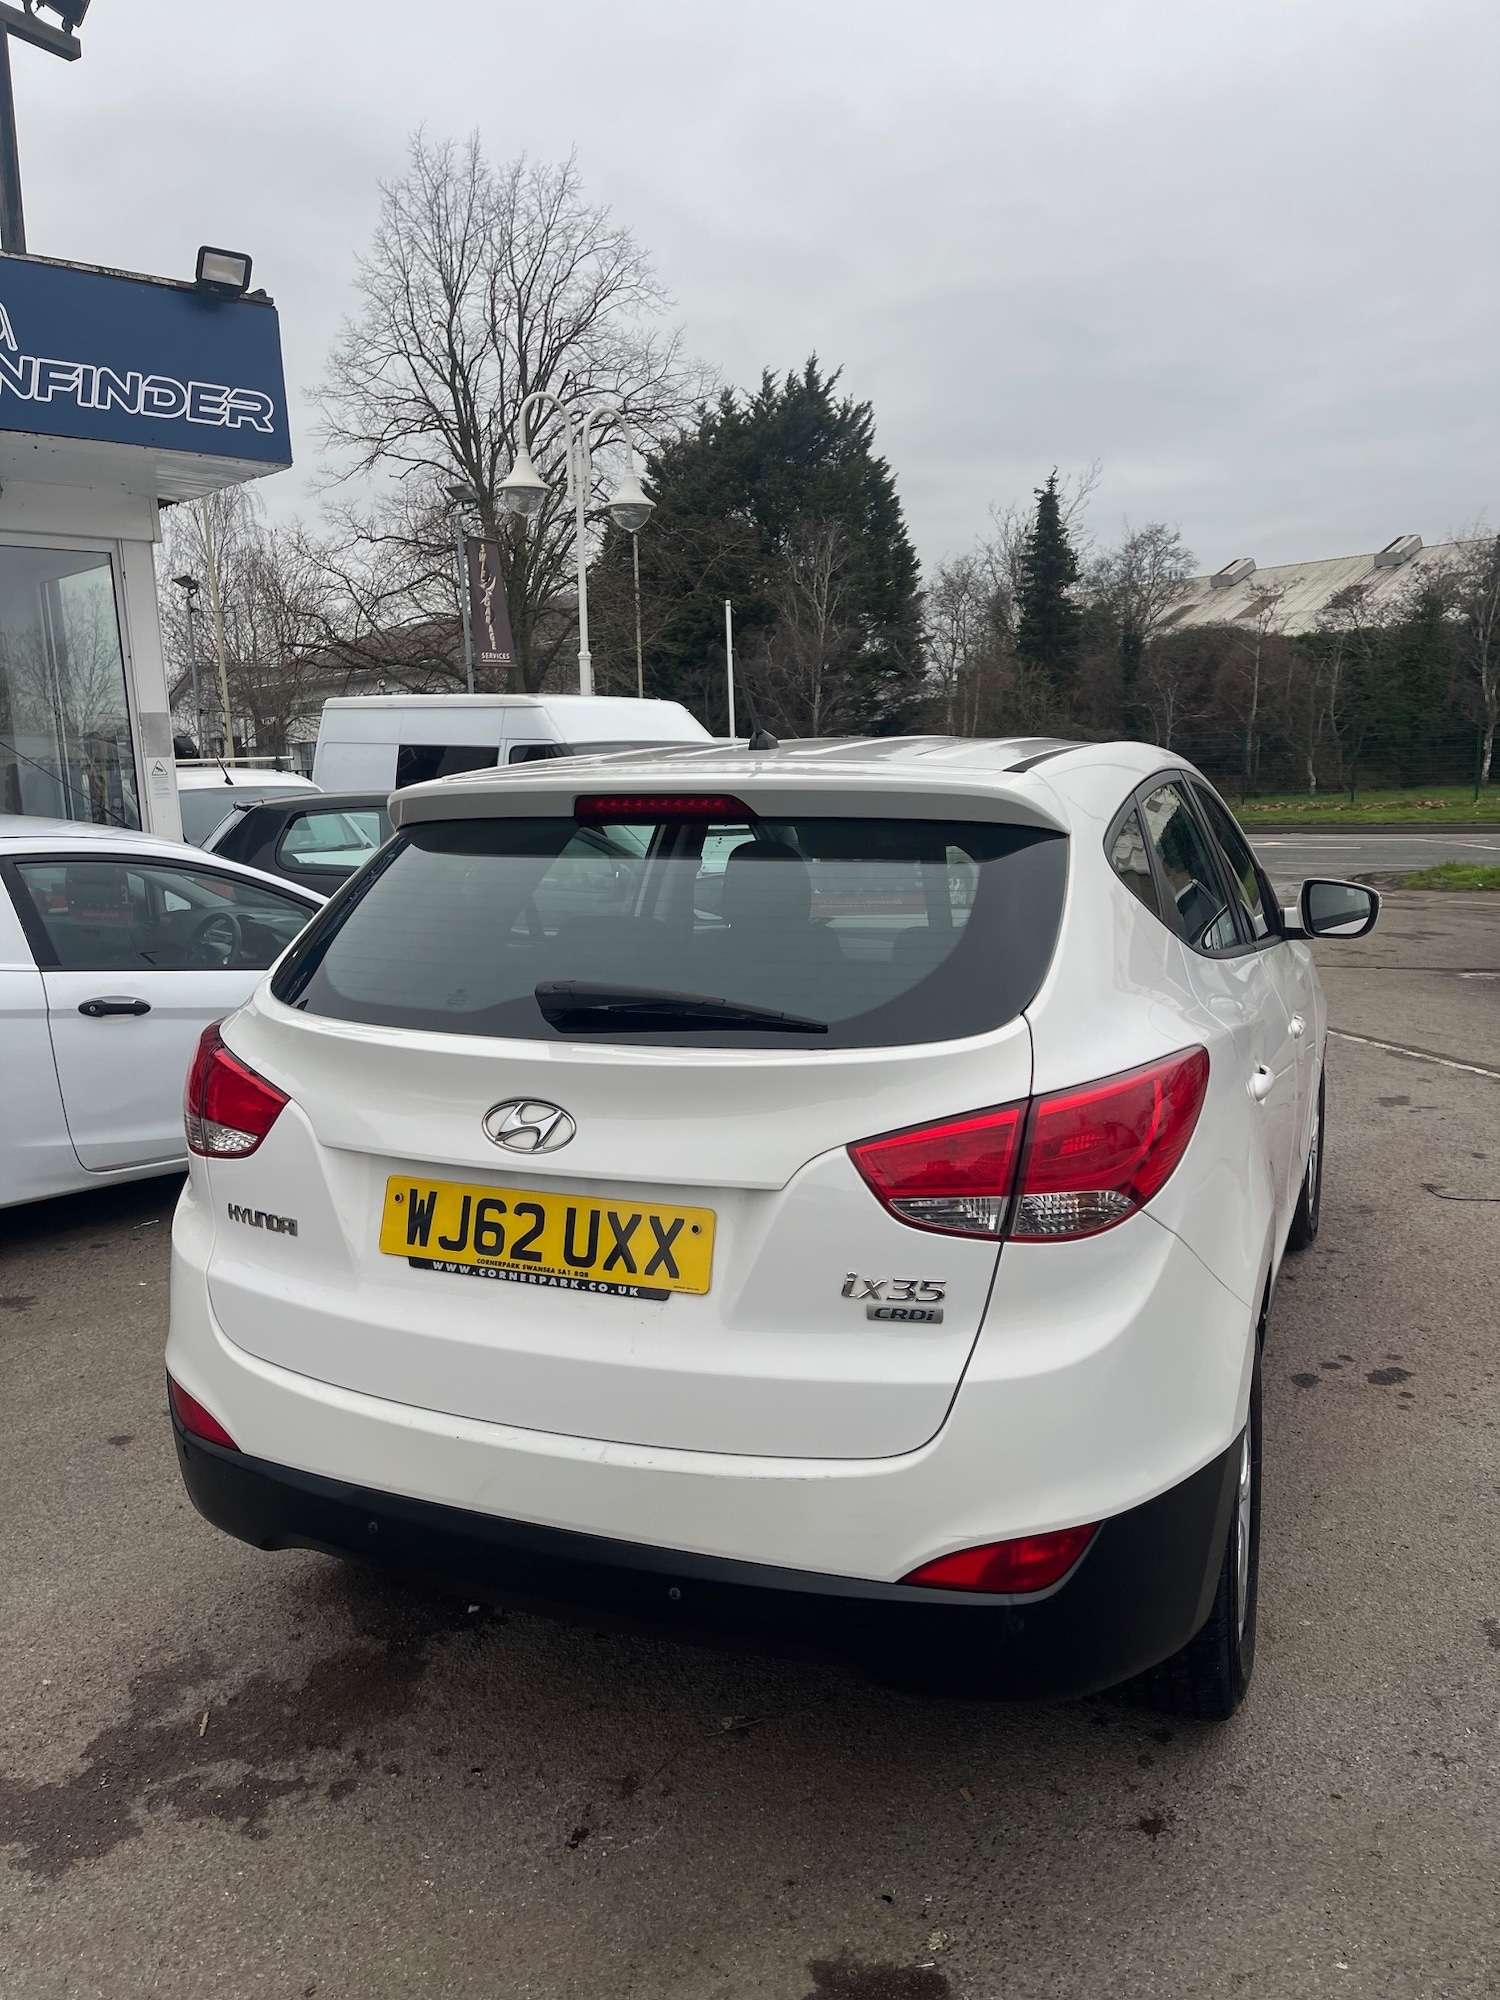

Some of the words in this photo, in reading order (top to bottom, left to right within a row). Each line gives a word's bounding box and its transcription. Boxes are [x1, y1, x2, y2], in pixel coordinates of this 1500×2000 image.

[484, 597, 497, 650] GARAGE
[481, 651, 511, 660] SERVICES
[228, 1203, 298, 1237] HYUNDAI
[406, 1188, 546, 1263] WJ62
[563, 1207, 686, 1279] UXX
[432, 1261, 640, 1297] WWW.CORNERPARK.CO.UK
[476, 1258, 521, 1270] CORNERPARK
[522, 1264, 556, 1274] SWANSEA
[557, 1268, 571, 1276] SA1
[874, 1307, 935, 1321] CRDi
